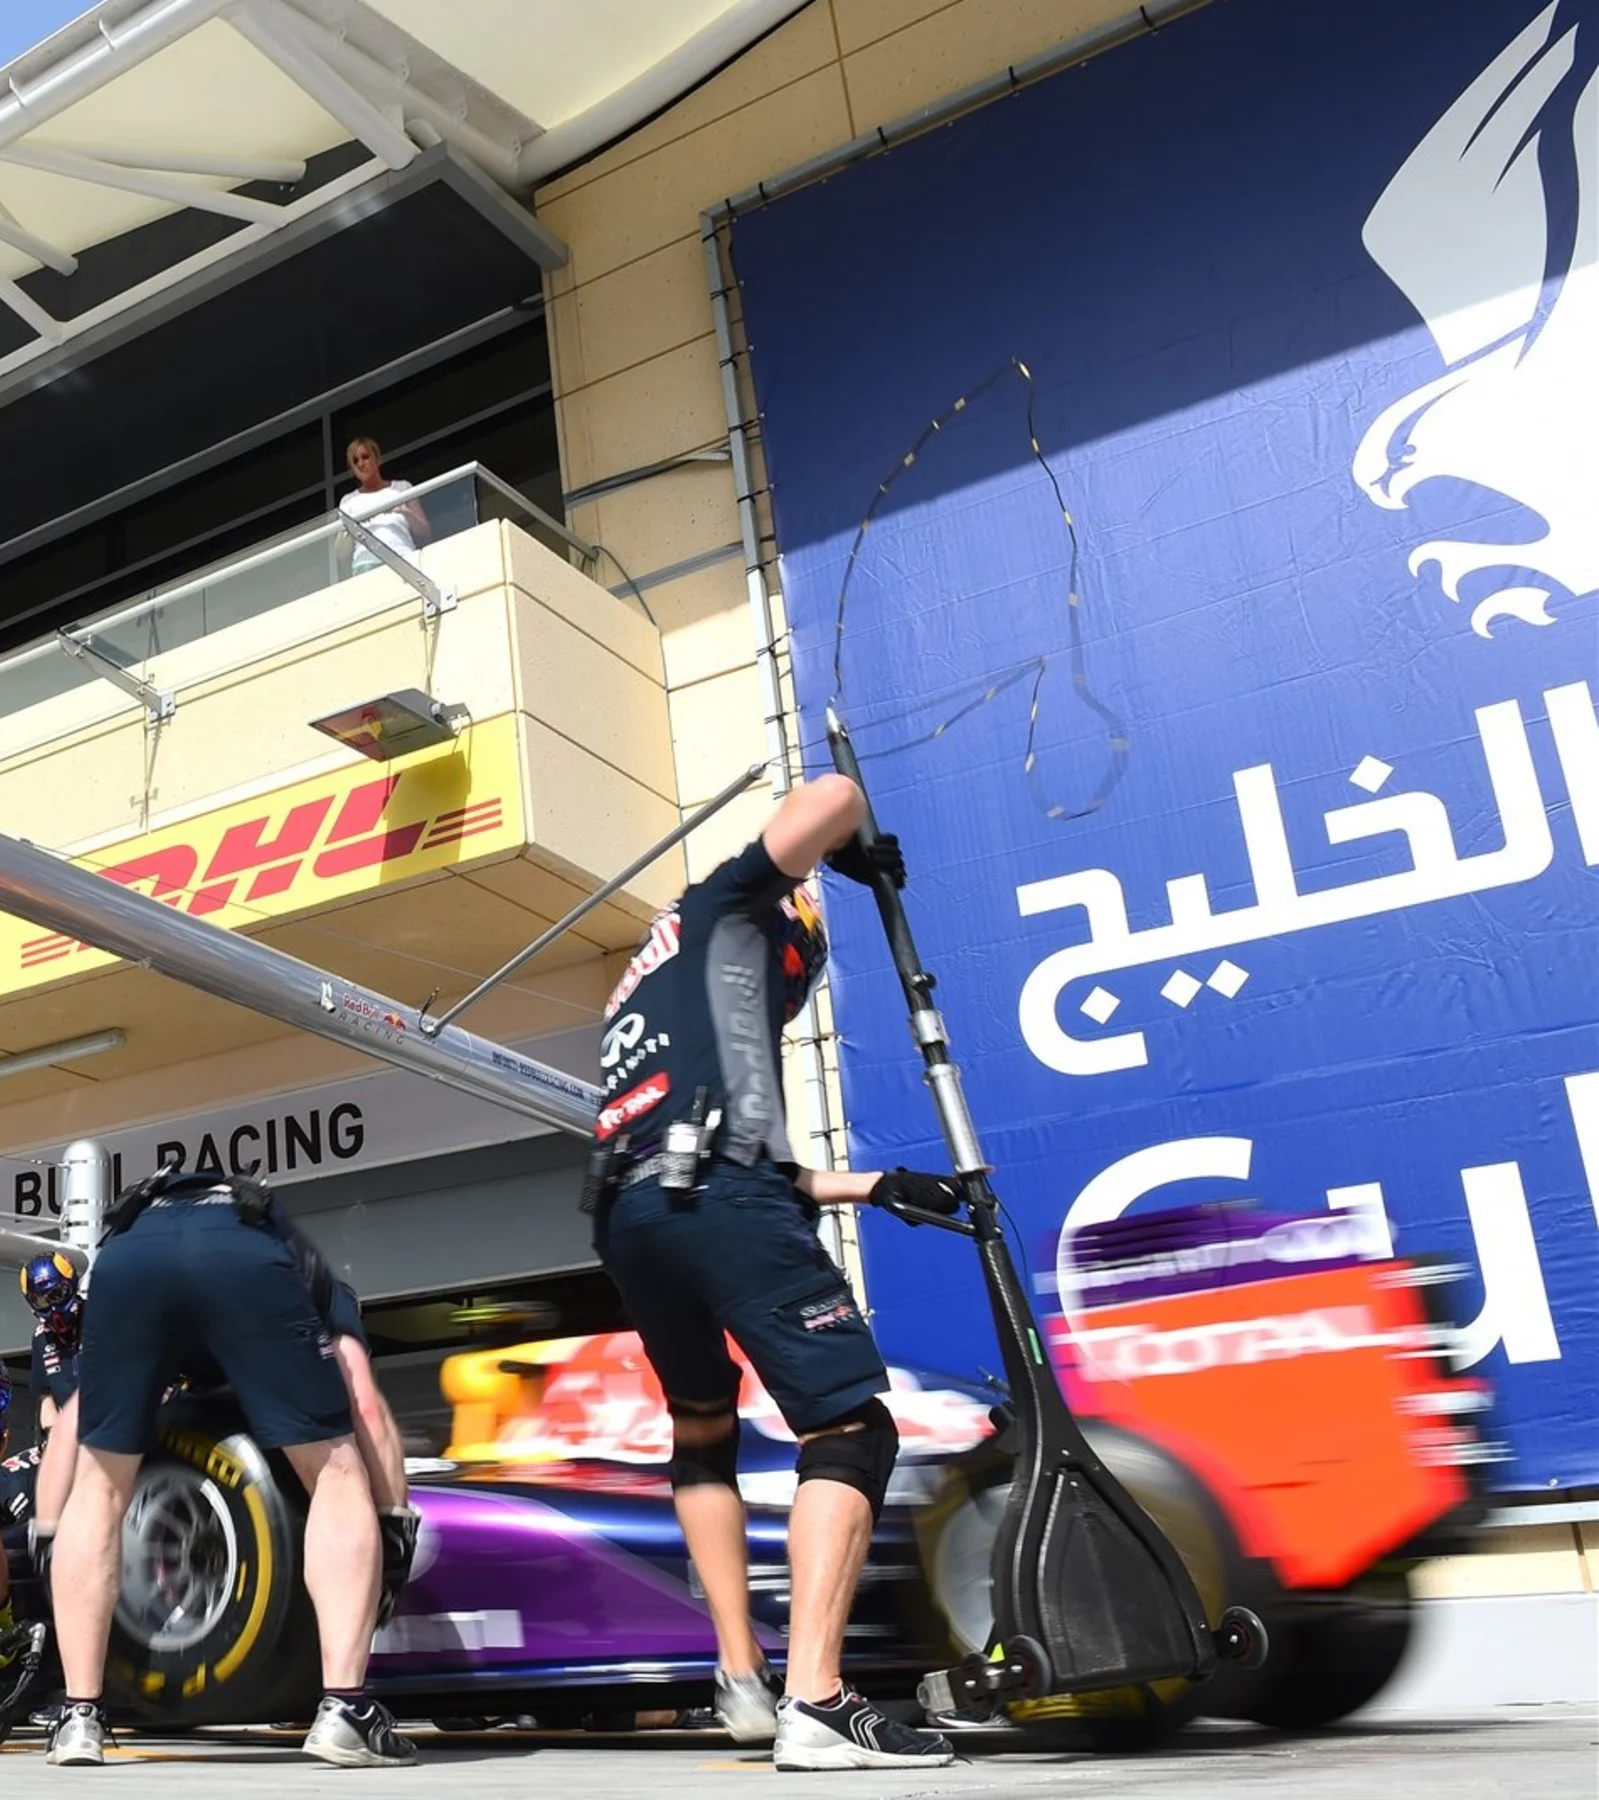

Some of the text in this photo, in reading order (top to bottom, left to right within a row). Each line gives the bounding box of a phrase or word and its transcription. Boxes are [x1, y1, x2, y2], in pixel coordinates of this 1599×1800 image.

[78, 772, 428, 951] DHL
[339, 1012, 404, 1045] RACING
[15, 1153, 122, 1223] BUL
[157, 1102, 364, 1176] RACING
[1057, 1073, 1599, 1385] Gu
